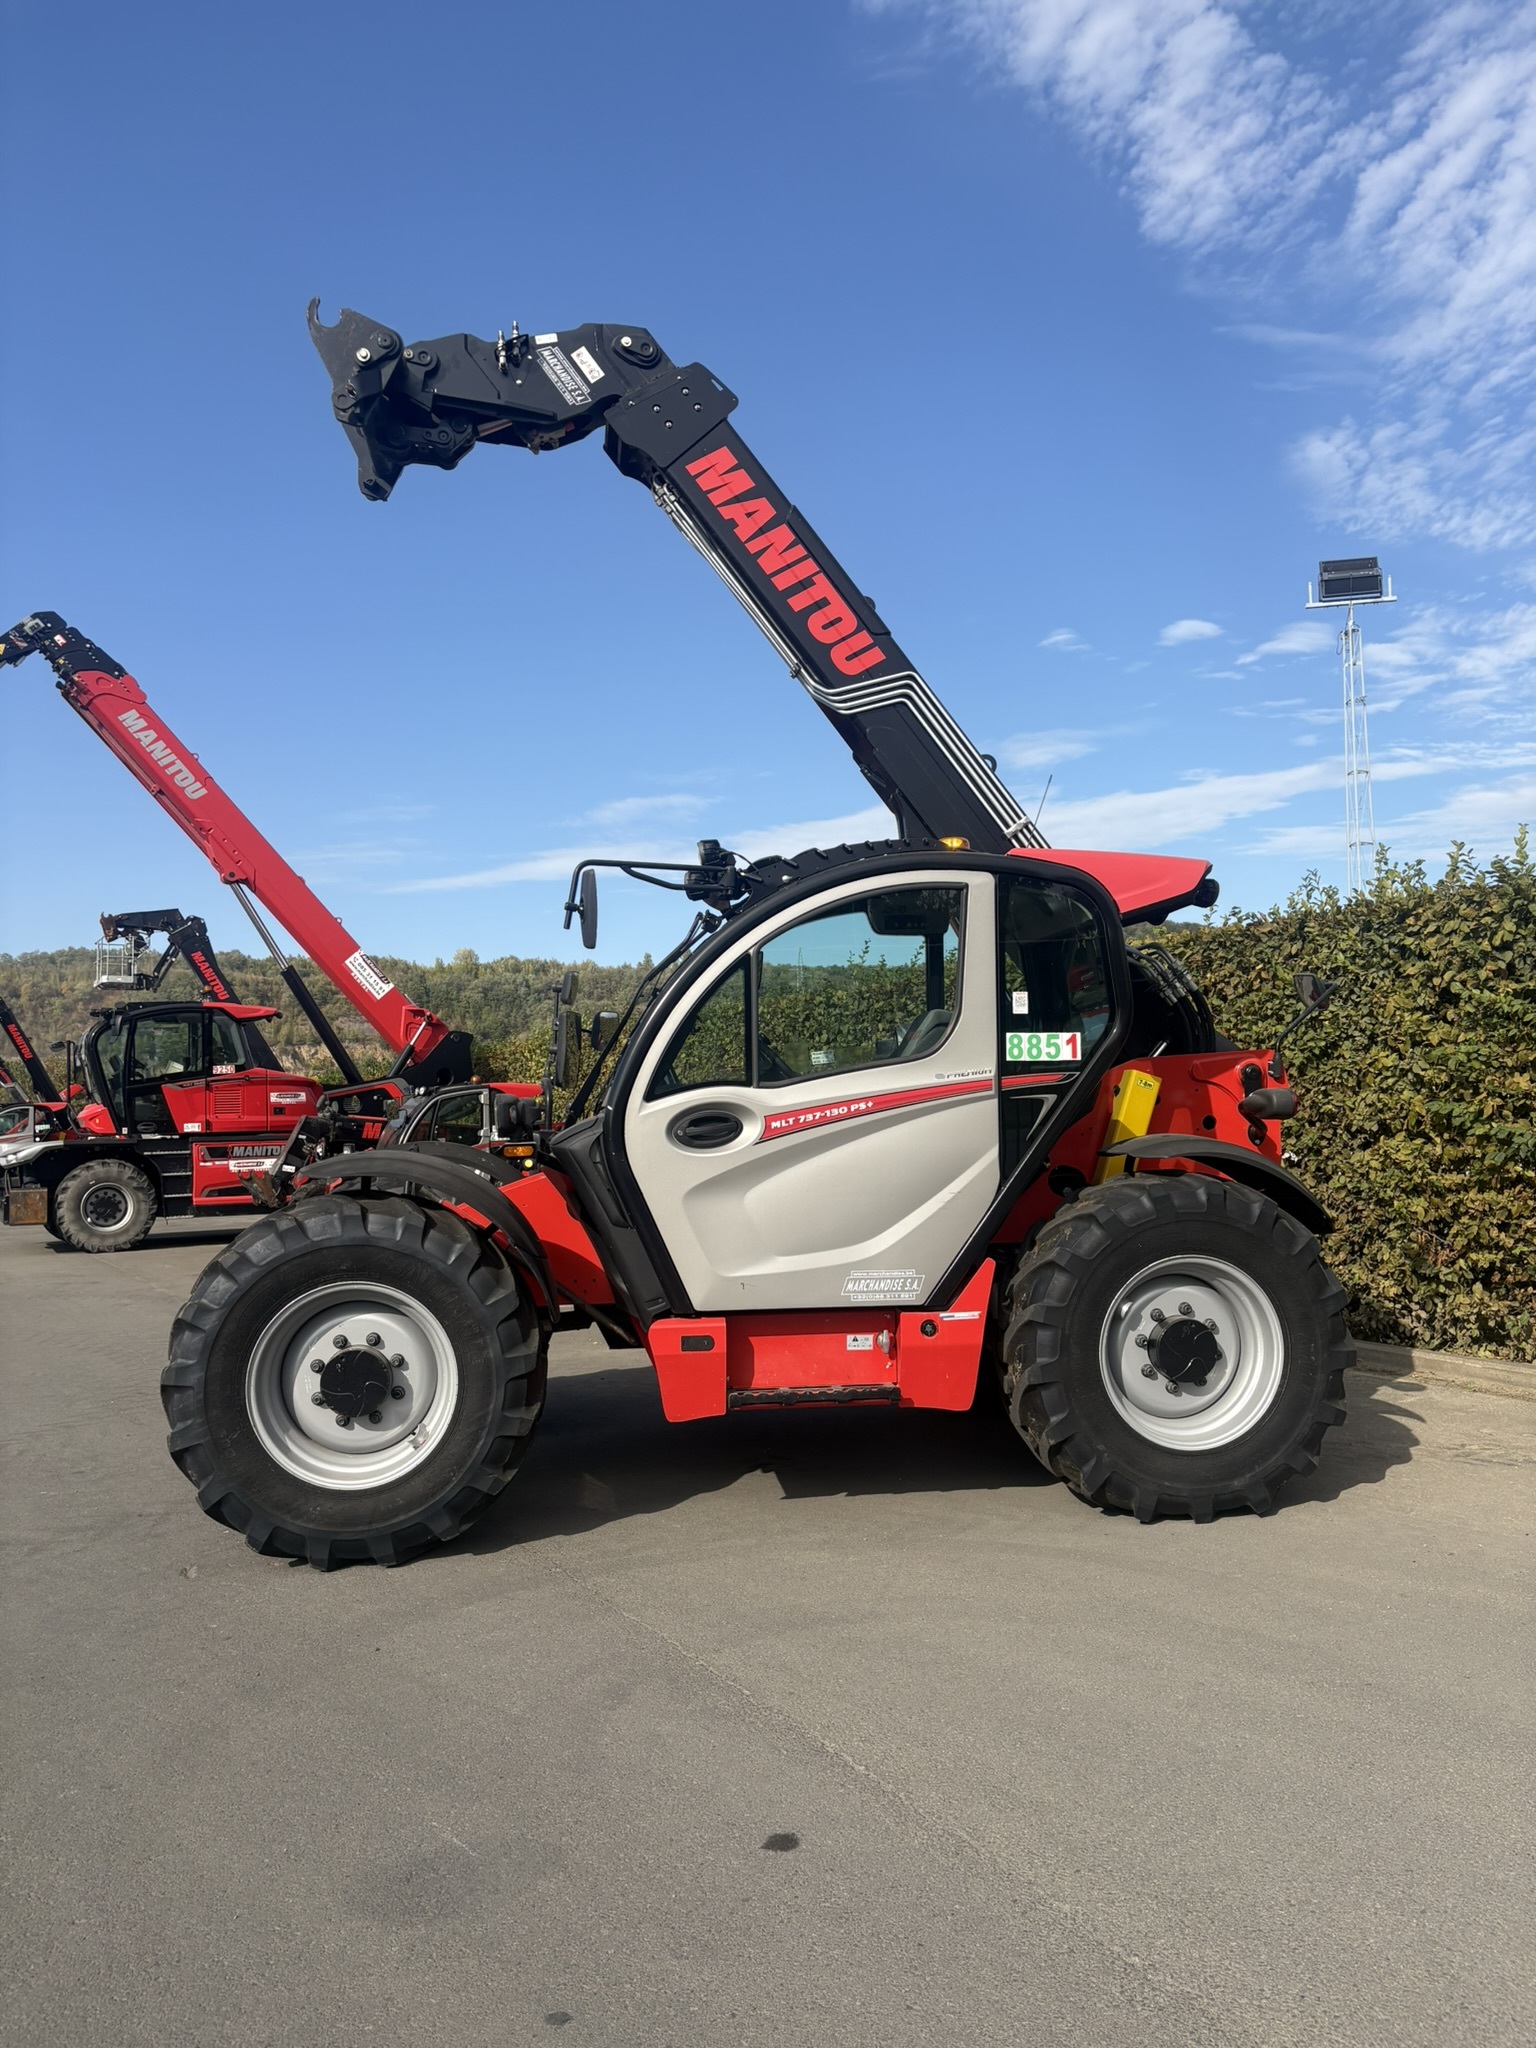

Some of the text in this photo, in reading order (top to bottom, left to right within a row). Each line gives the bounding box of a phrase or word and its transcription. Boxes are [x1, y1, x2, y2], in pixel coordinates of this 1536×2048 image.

[540, 348, 578, 391] MARCHANDISE
[685, 445, 886, 676] MANITOU
[117, 708, 208, 800] MANITOU
[191, 950, 230, 1000] MANITOU
[7, 1023, 33, 1059] MANITOU
[1008, 1033, 1078, 1060] 8851
[771, 1100, 874, 1129] MLT 737-130 PS+
[845, 1279, 904, 1292] MARCHANDISE
